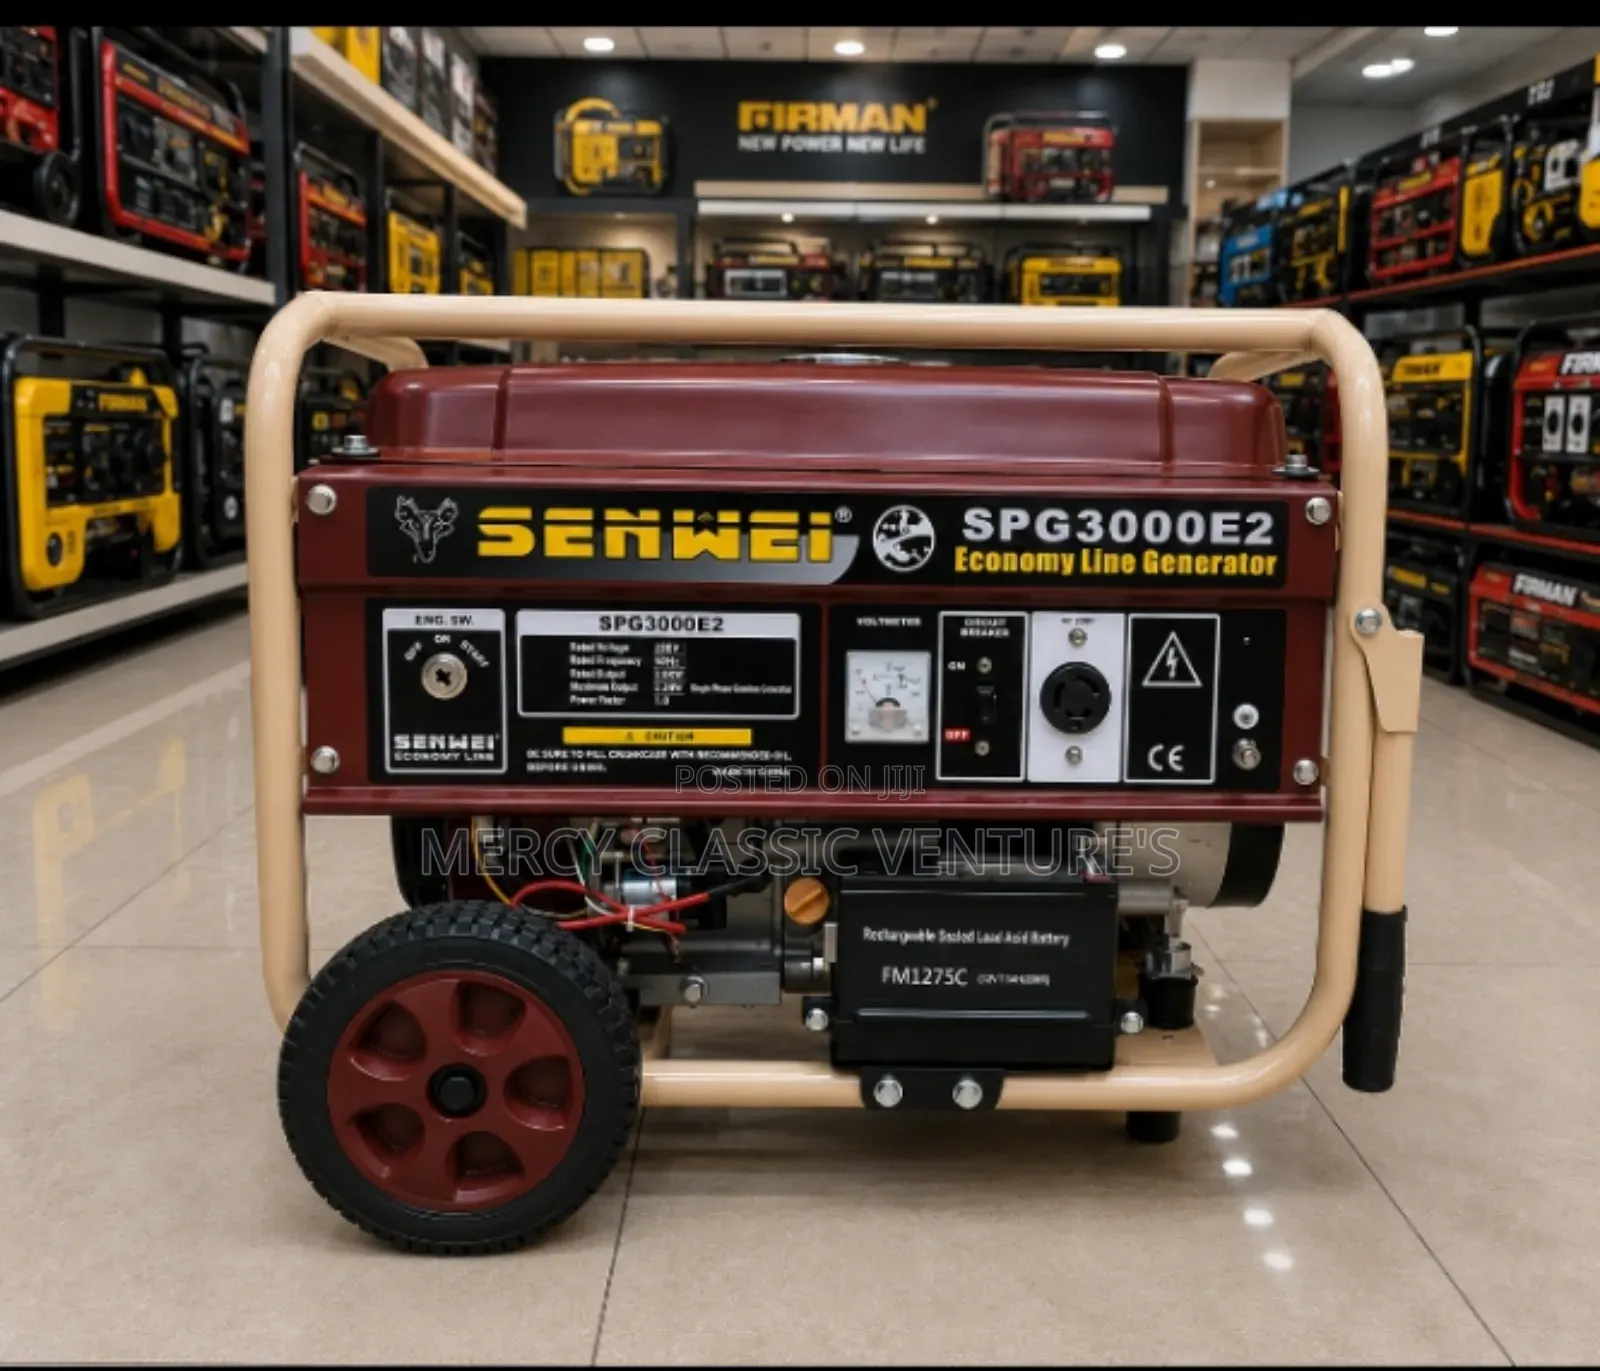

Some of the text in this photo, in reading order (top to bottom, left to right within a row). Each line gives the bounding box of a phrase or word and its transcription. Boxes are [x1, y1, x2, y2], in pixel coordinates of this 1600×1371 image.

[738, 101, 927, 132] FIRMAN
[738, 135, 926, 154] NEW POWER NEW LIFE
[962, 507, 1274, 546] SPG3000E2
[954, 546, 1279, 577] Economy Line Generator
[1513, 573, 1578, 607] FIRMAN
[599, 615, 725, 632] SPG3000E2
[393, 734, 495, 750] SENWEI
[1147, 744, 1185, 772] CE
[881, 965, 969, 986] FM1275C
